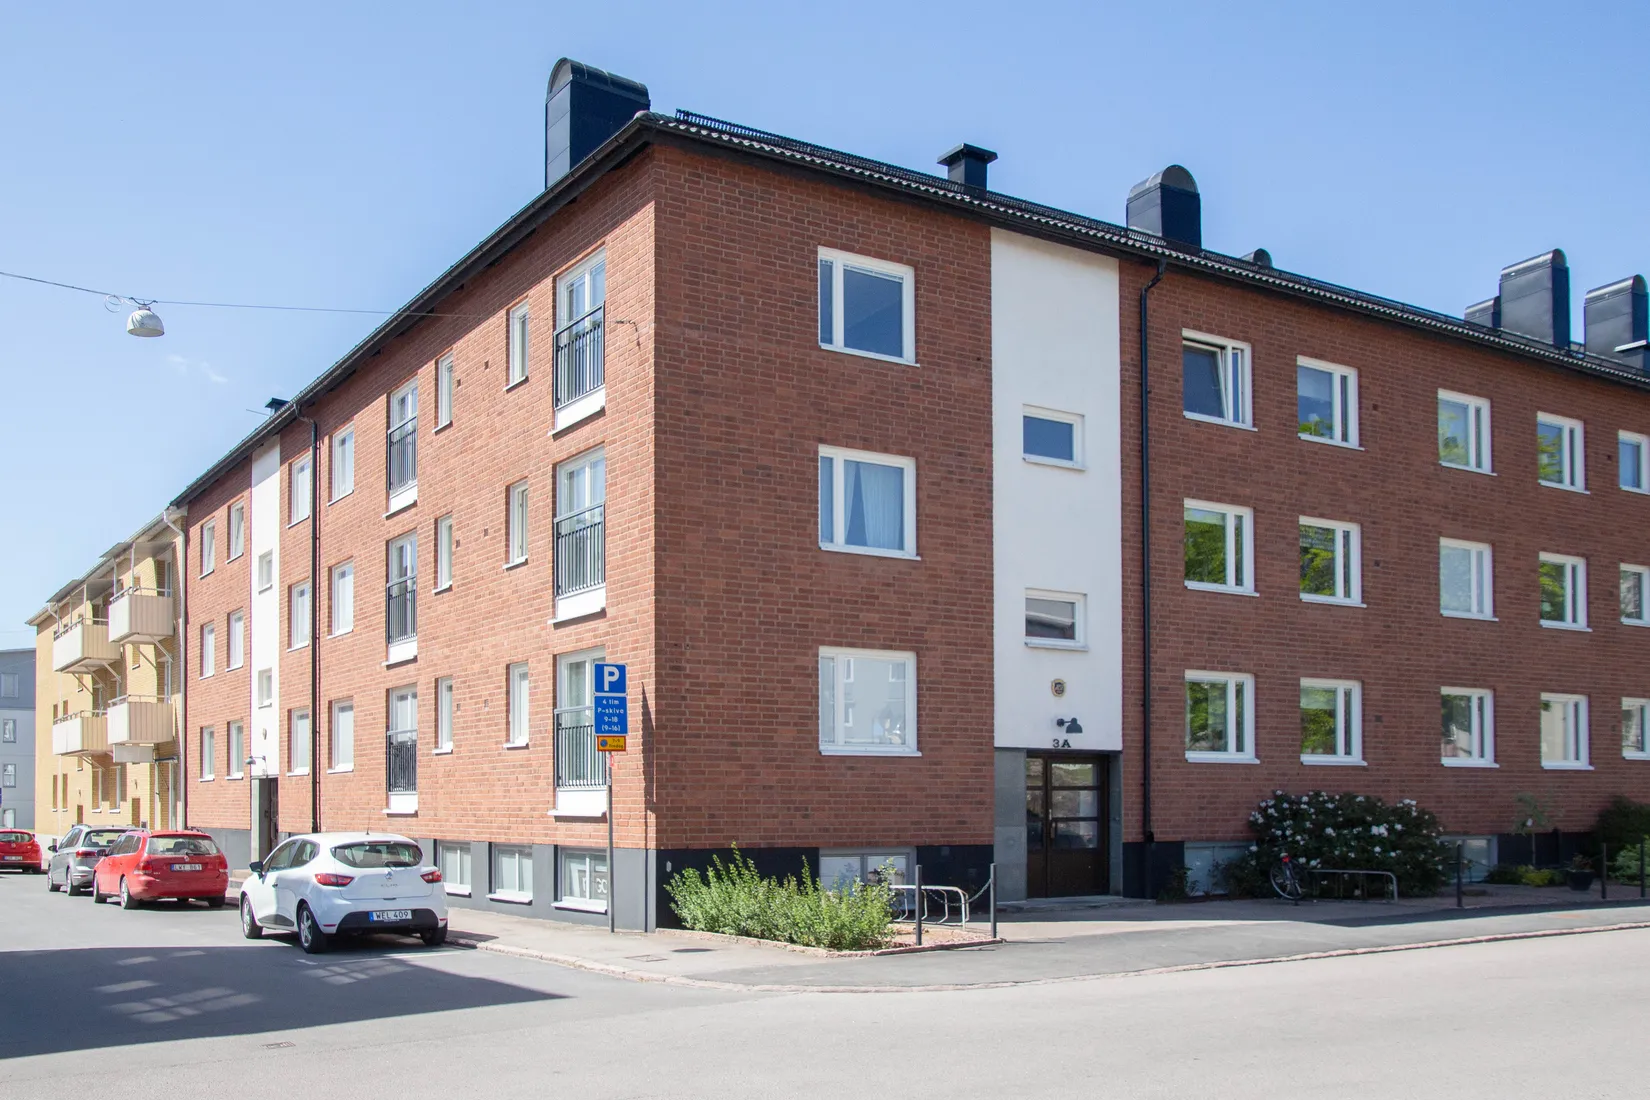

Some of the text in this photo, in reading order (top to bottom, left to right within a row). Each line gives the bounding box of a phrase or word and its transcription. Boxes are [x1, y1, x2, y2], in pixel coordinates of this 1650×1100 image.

[604, 666, 620, 691] P
[601, 724, 621, 732] (9-16)
[1052, 738, 1071, 748] 3A
[375, 911, 391, 920] WEL
[393, 910, 409, 919] 409
